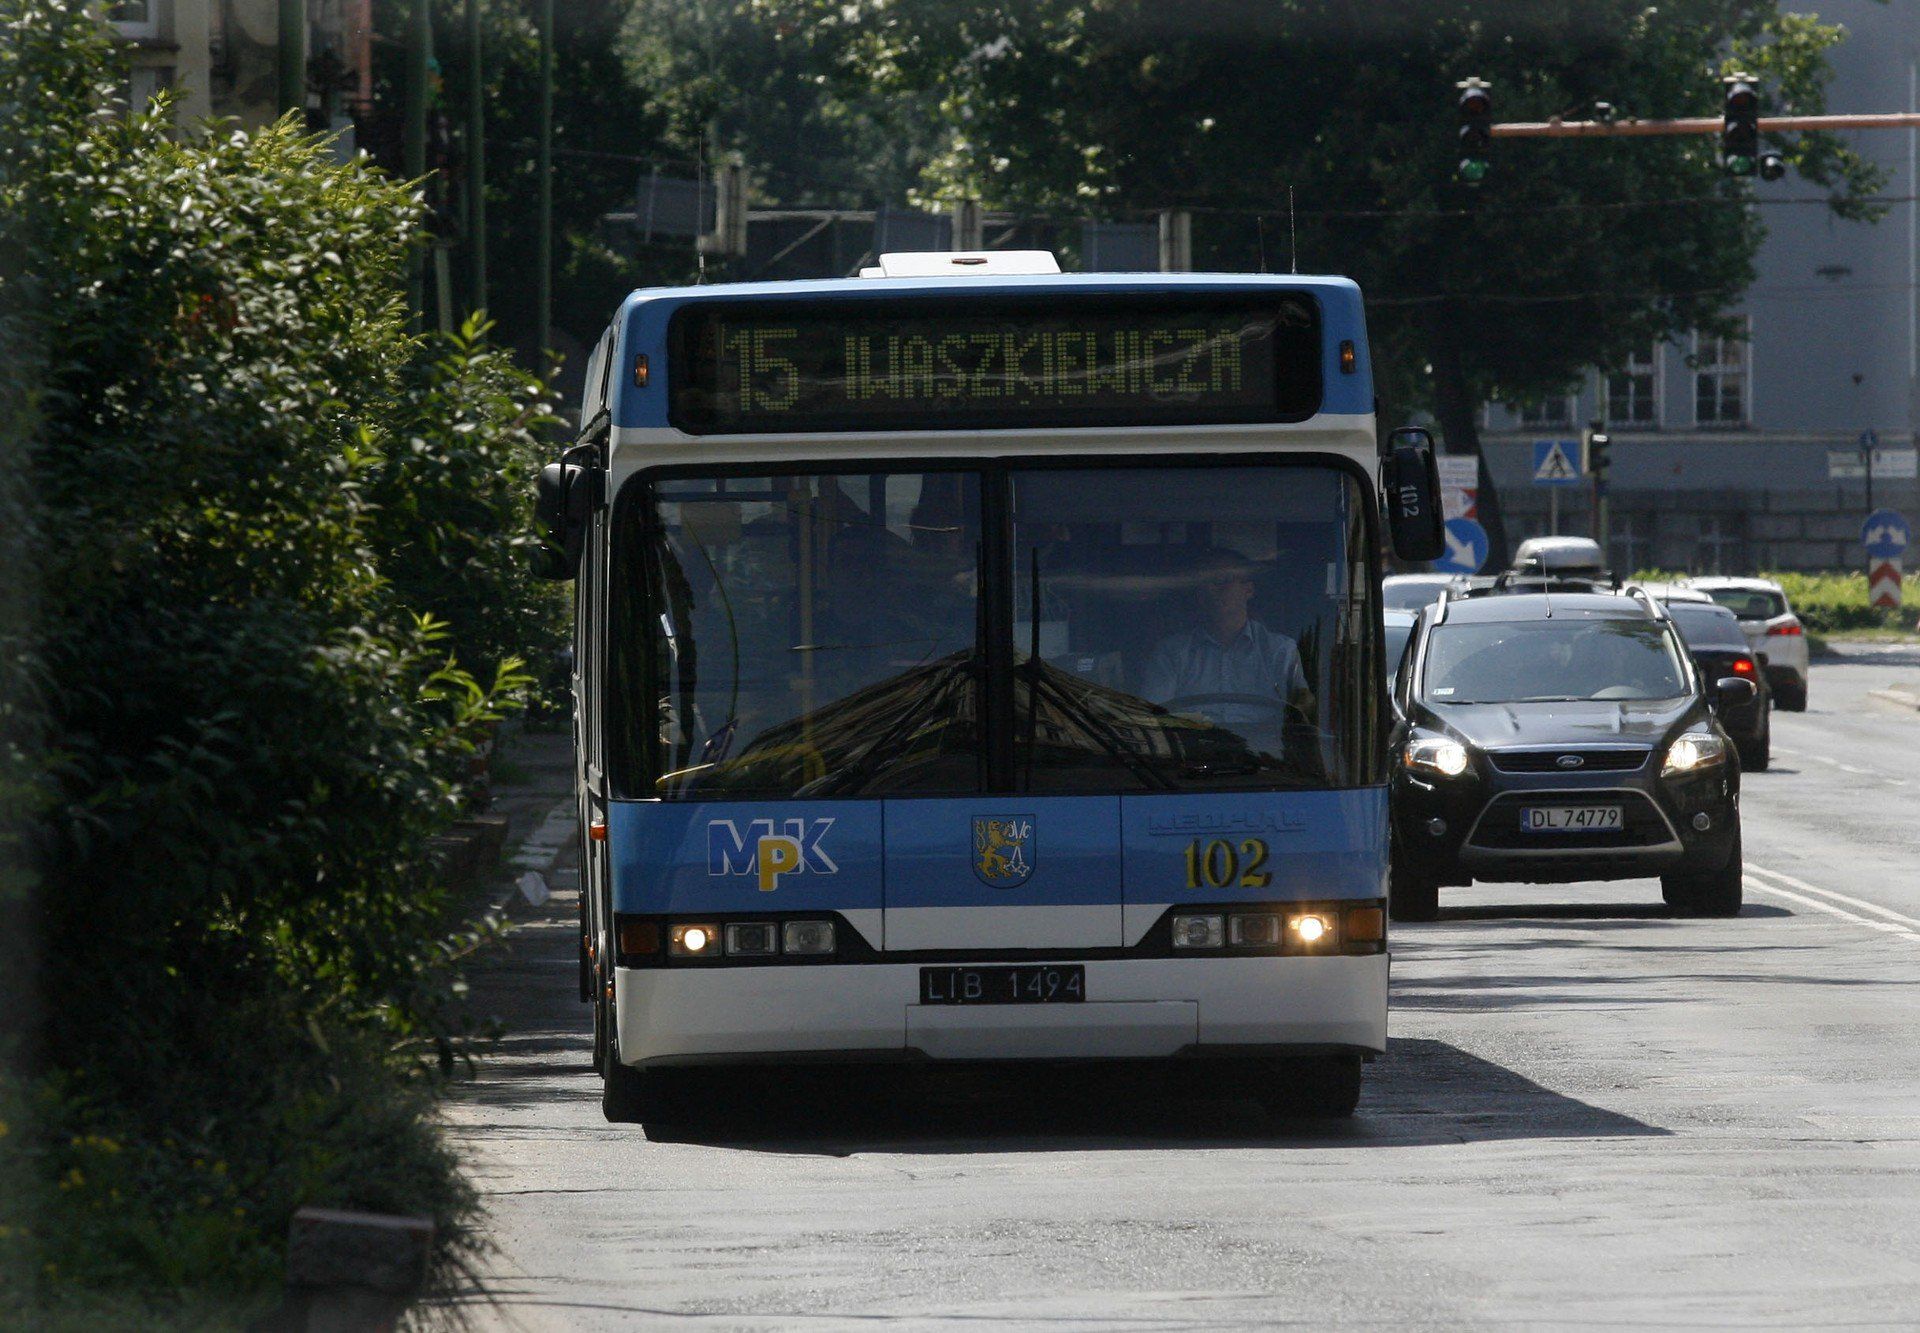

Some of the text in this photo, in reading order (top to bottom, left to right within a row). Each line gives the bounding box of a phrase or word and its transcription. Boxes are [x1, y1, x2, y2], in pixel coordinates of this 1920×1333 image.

[725, 329, 1241, 411] 15 IWASZKIEWICZA
[1400, 485, 1419, 518] 102
[1532, 810, 1557, 827] DL
[1564, 809, 1618, 827] 74779
[708, 817, 840, 893] MPK
[1184, 838, 1273, 888] 102
[928, 971, 1081, 999] LIB 1494
